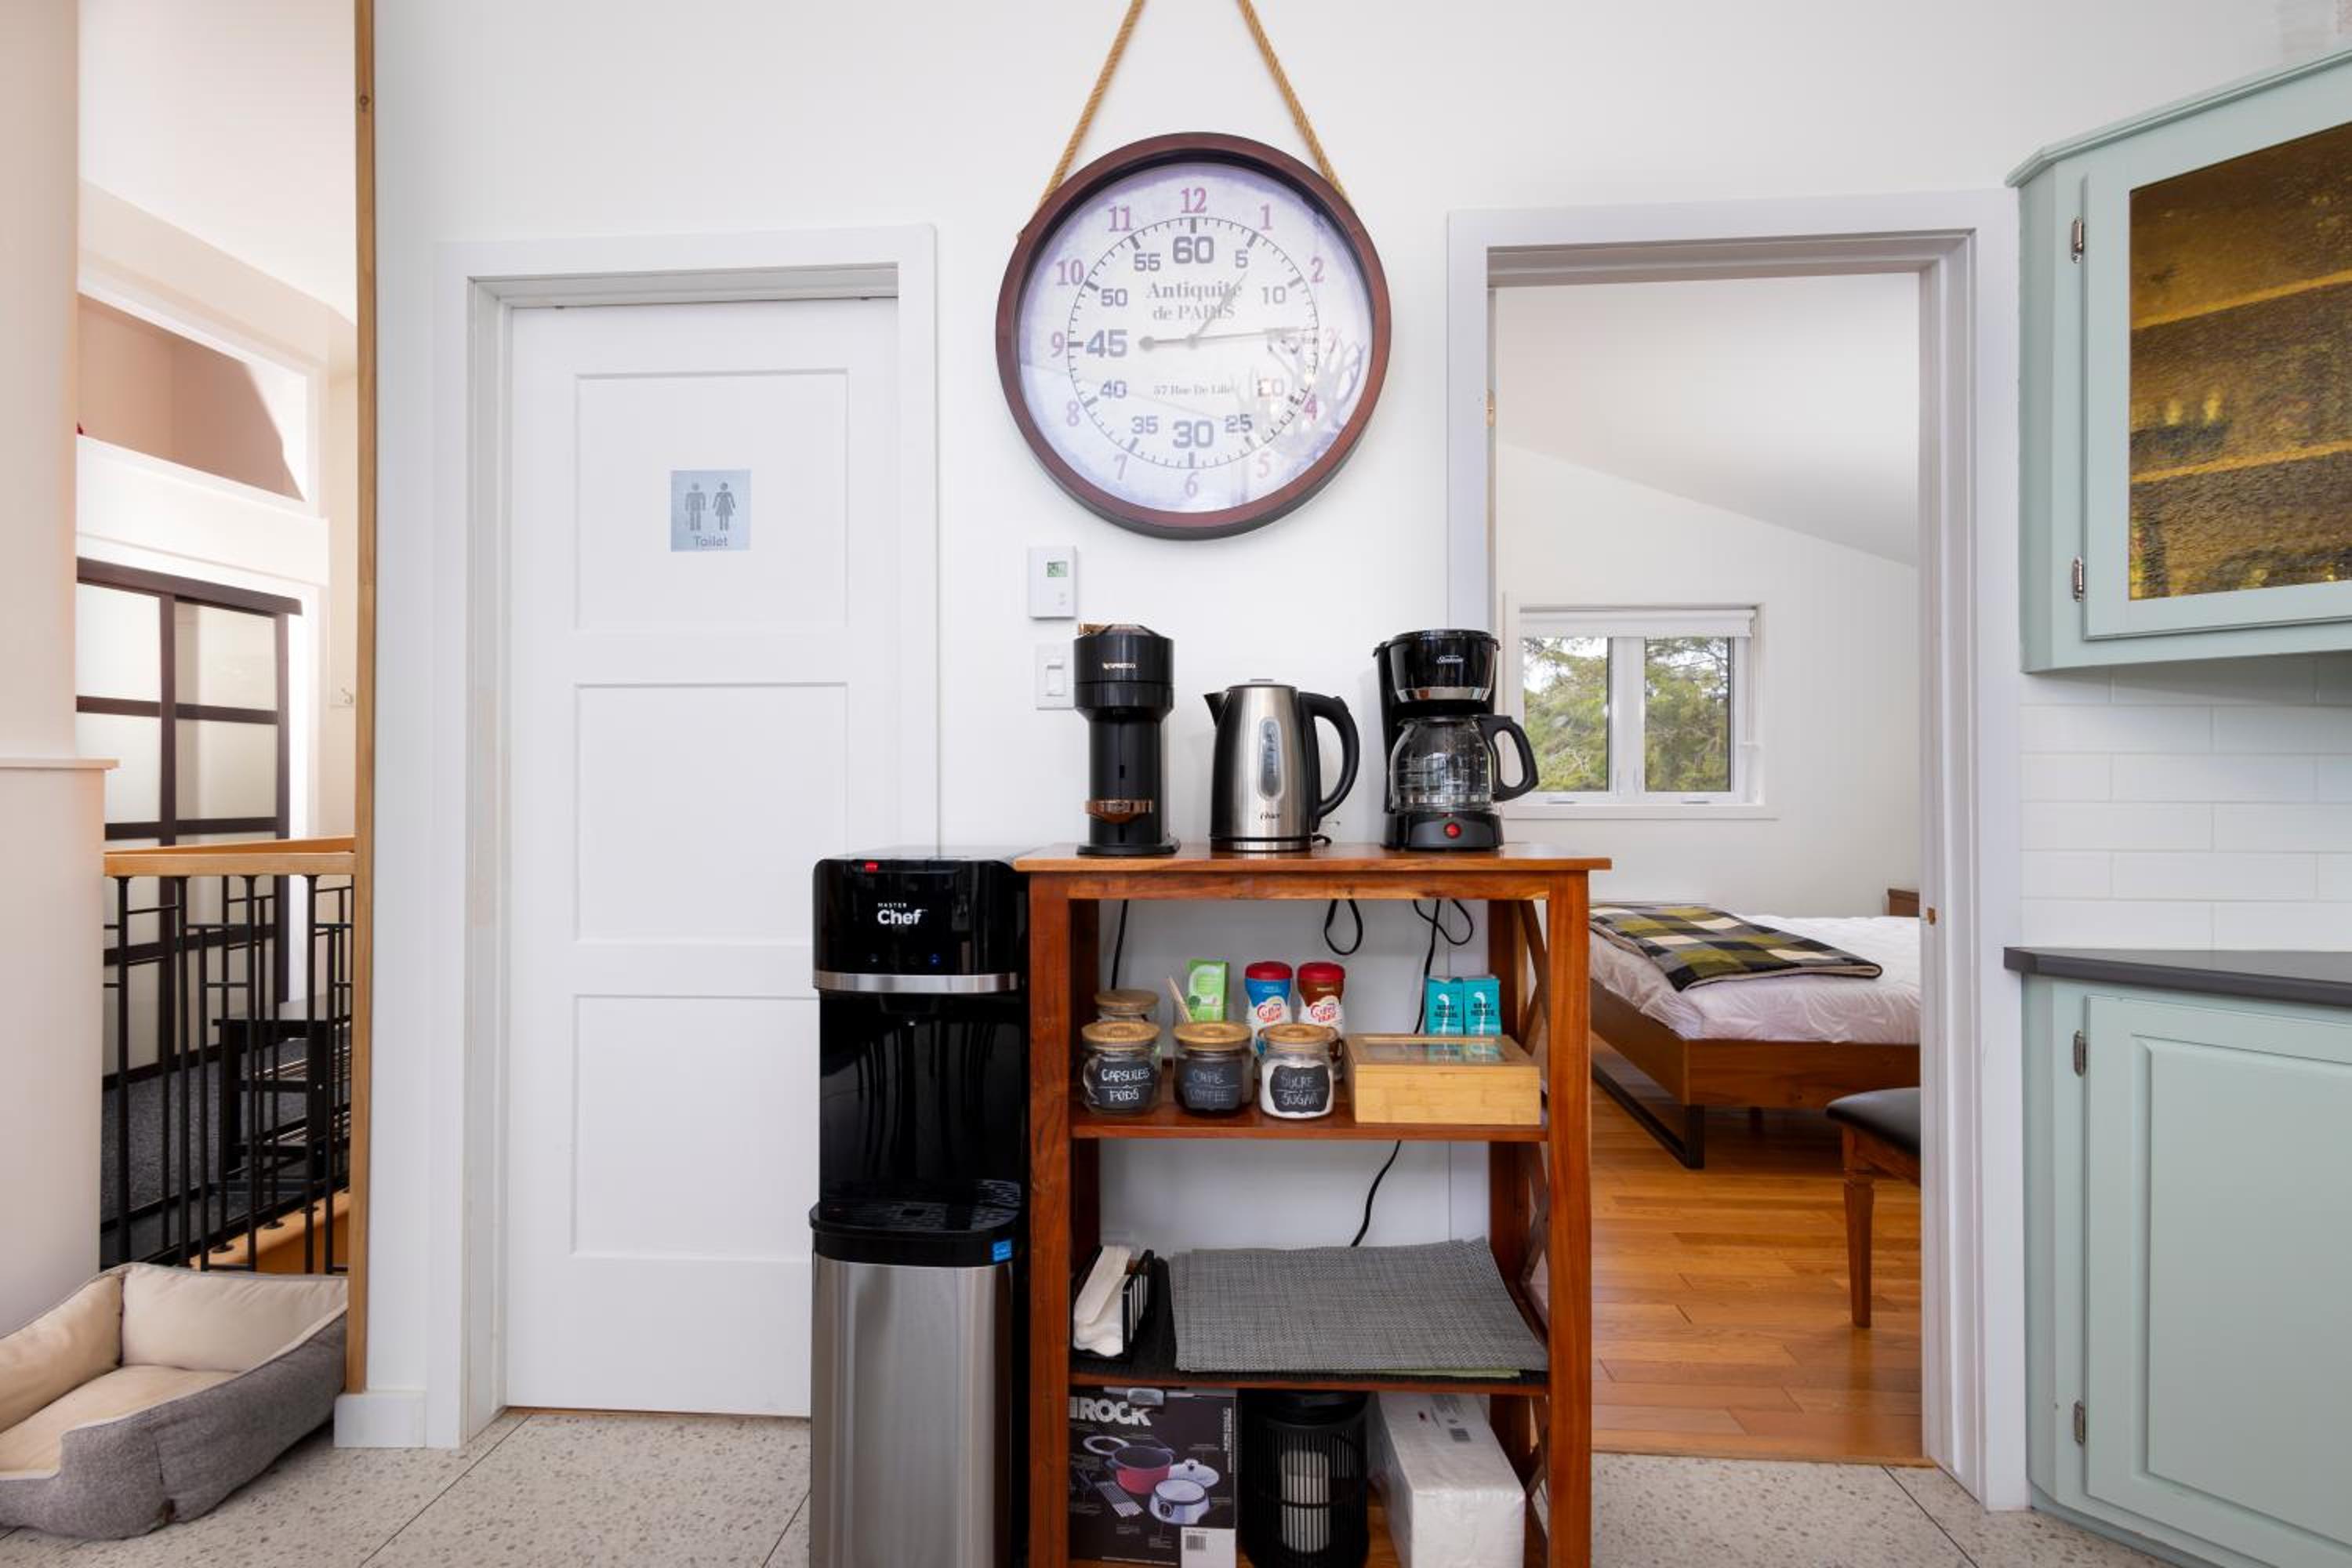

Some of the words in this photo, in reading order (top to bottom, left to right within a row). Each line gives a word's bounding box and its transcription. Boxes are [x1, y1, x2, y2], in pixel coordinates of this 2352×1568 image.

[1180, 188, 1207, 212] 12
[1108, 207, 1134, 230] 11
[1260, 205, 1273, 230] 1
[1134, 253, 1160, 270] 55
[1173, 237, 1214, 263] 60
[1234, 250, 1248, 268] 5
[1056, 260, 1083, 285] 10
[1311, 257, 1325, 281] 2
[1101, 289, 1127, 306] 50
[1261, 286, 1286, 303] 10
[1152, 306, 1172, 319] de
[1051, 333, 1064, 357] 9
[1087, 330, 1127, 357] 45
[1101, 380, 1127, 397] 40
[1066, 401, 1080, 426] 8
[1304, 394, 1318, 420] 4
[1131, 416, 1158, 434] 35
[1173, 421, 1214, 448] 30
[1225, 415, 1252, 433] 25
[1113, 453, 1127, 480] 7
[1258, 453, 1270, 477] 5
[1185, 472, 1198, 498] 6
[692, 535, 728, 546] Toilet
[877, 909, 922, 924] Chef
[1101, 1067, 1150, 1082] CAPSULES
[1109, 1089, 1139, 1102] PODS
